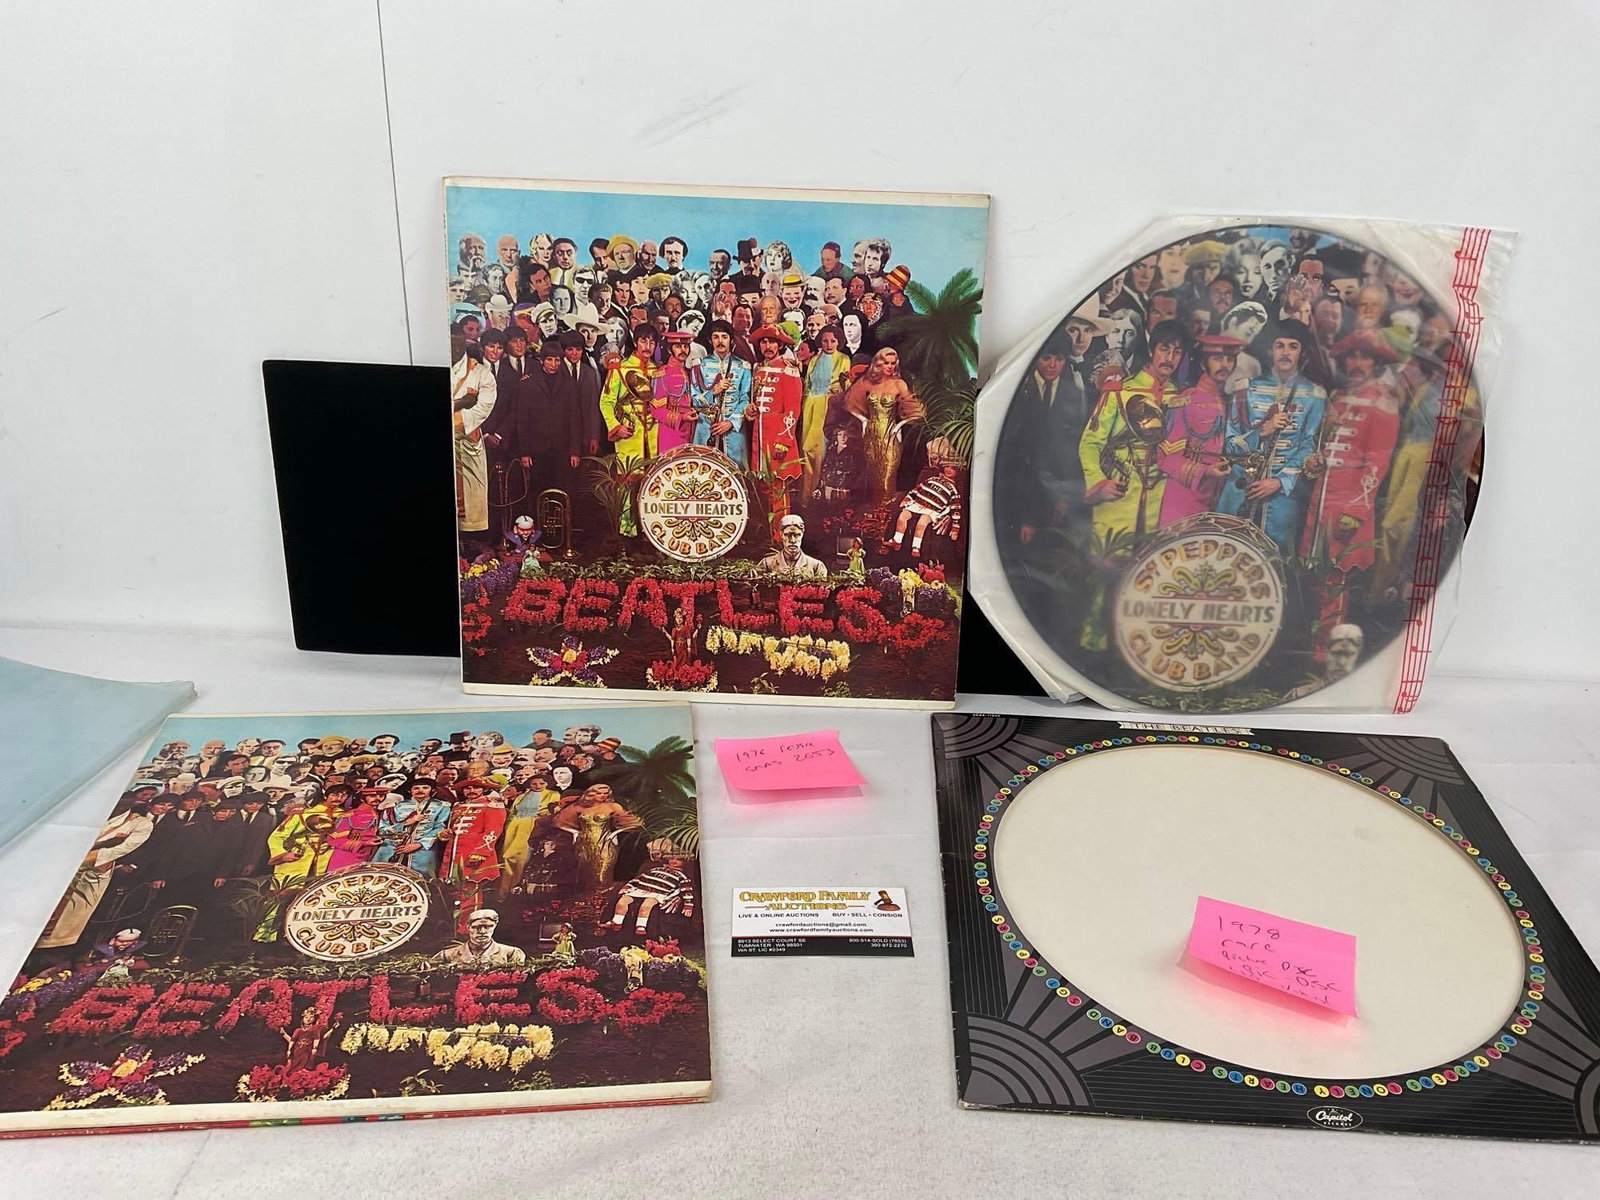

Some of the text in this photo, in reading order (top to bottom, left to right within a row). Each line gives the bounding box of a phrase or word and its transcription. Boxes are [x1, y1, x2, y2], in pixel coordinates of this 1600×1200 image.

[662, 461, 738, 500] PEPPERS
[643, 502, 743, 516] LONELY HEARTS
[650, 521, 737, 554] CLUB BAND
[1159, 539, 1271, 600] PEPPERS
[504, 577, 886, 645] BEATLES
[1122, 600, 1275, 623] LONELY HEARTS
[1129, 629, 1261, 681] CLUB BAND
[326, 875, 418, 904] PEPPERS
[739, 890, 872, 902] CRAWFORD FAMILY
[974, 862, 999, 912] LONELY
[293, 905, 422, 922] LONELY HEARTS
[765, 902, 848, 911] AUCTIONS
[296, 921, 411, 955] CLUB BAND
[1218, 916, 1280, 940] 1978
[992, 915, 1047, 976] PEPPERS
[46, 967, 602, 1039] BEATLES
[1046, 977, 1081, 1006] SGT
[1086, 1008, 1141, 1044] BAND
[1146, 1041, 1206, 1072] CLUB
[1213, 1066, 1307, 1096] HEARTS
[1406, 1055, 1489, 1092] PEPPERS
[1314, 1081, 1402, 1099] LONELY
[1316, 1110, 1353, 1122] Capitol
